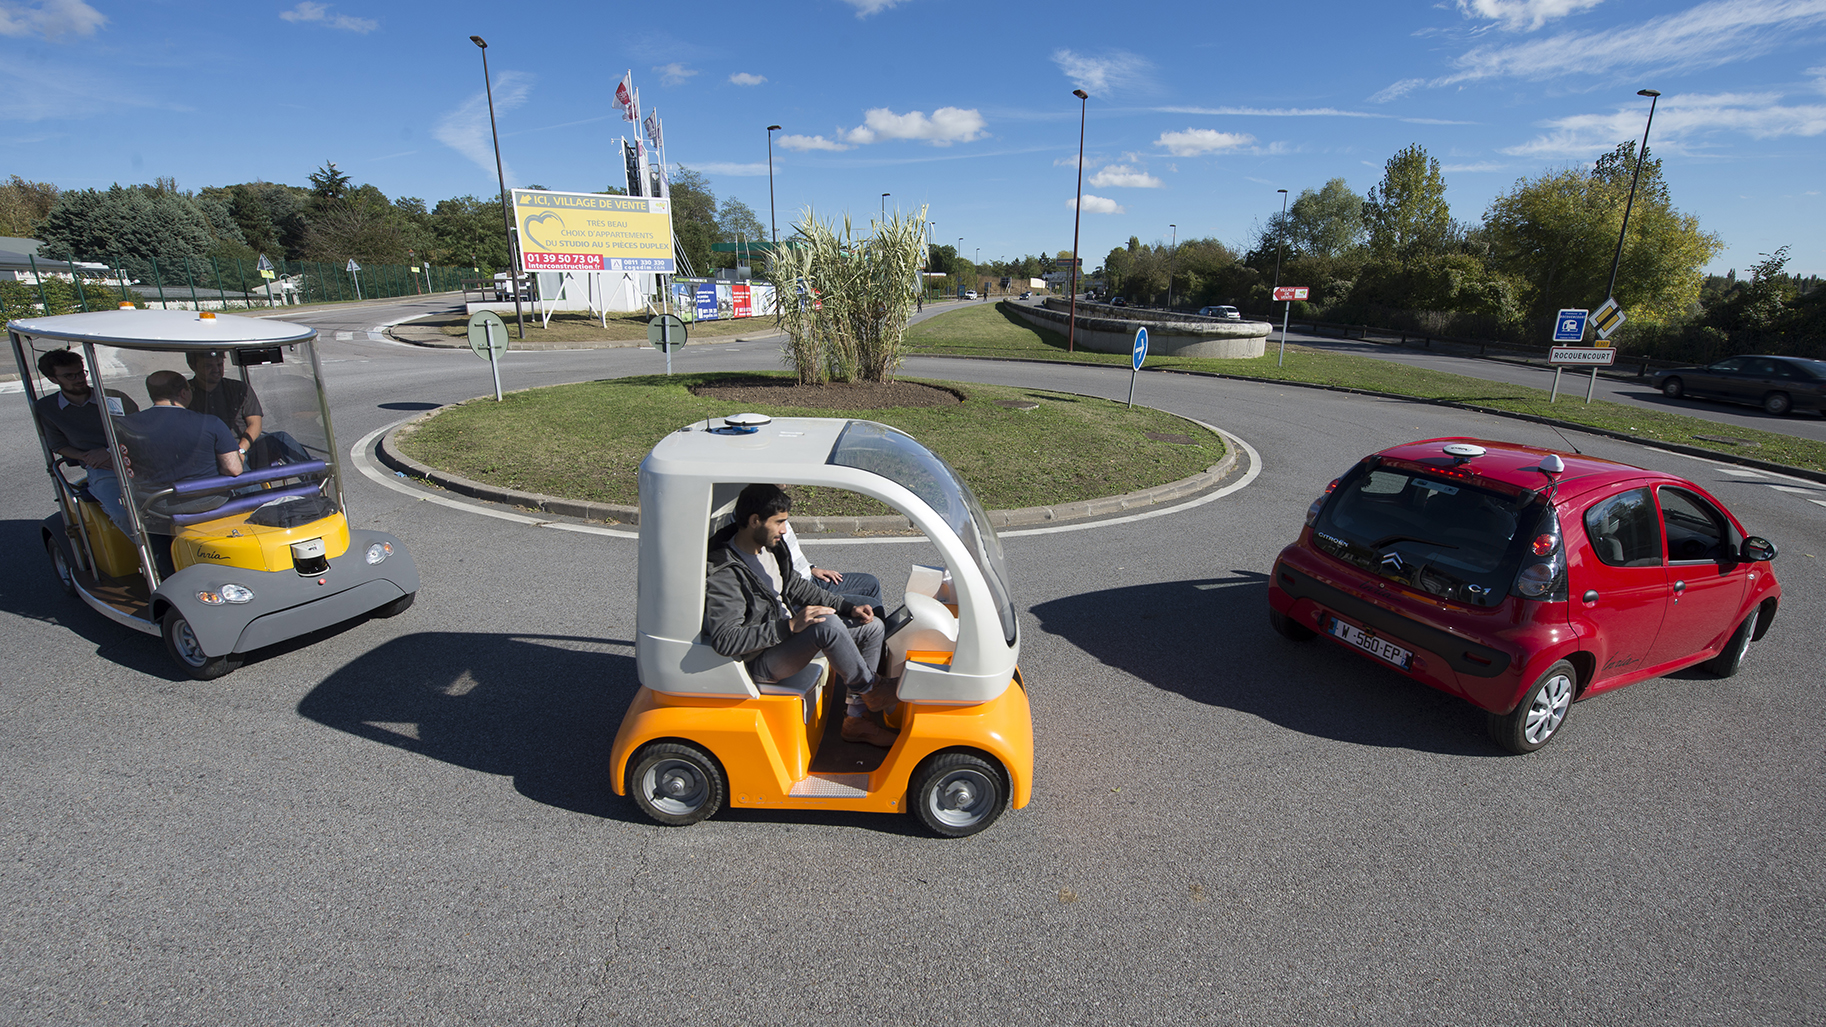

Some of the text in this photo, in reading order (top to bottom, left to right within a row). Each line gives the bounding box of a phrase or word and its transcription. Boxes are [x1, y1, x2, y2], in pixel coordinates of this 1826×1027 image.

[533, 195, 551, 206] ICI,
[553, 196, 597, 208] VILLAGE
[599, 200, 613, 209] DE
[615, 200, 646, 210] VENTE
[586, 219, 628, 228] TRÈS BEAU
[560, 229, 654, 239] CHOIX D'APPARTEMENTS
[559, 240, 590, 248] STUDIO
[612, 241, 638, 249] PIÈCES
[639, 242, 670, 250] DUPLEX
[527, 253, 600, 264] 01 39 50 73 04
[1554, 352, 1610, 360] ROCQUENCOURT
[1318, 531, 1349, 548] CITROËN
[1468, 583, 1492, 596] C1
